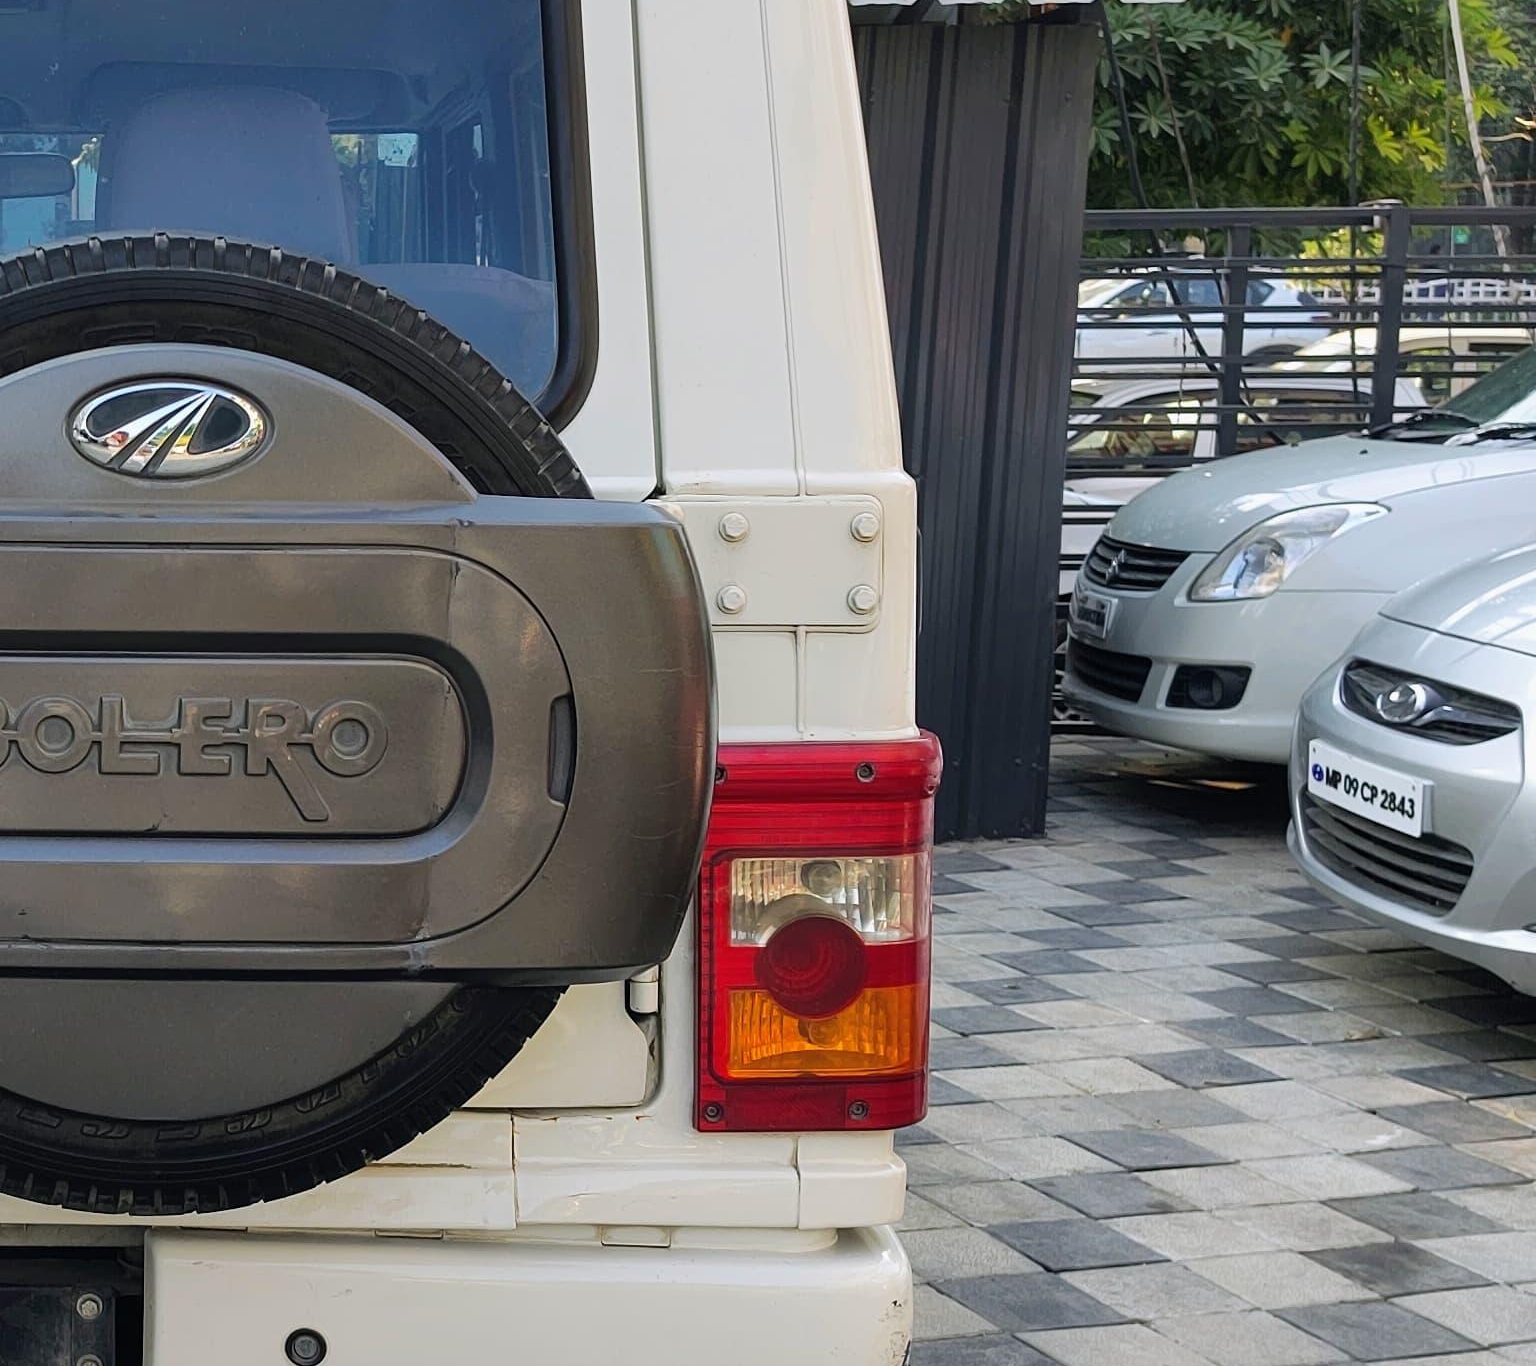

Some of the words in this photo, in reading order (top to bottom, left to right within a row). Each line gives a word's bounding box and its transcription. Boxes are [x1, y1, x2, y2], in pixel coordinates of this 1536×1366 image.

[1325, 766, 1342, 790] MP
[1344, 774, 1359, 798] 09
[1360, 781, 1379, 805] CP
[1380, 789, 1415, 819] 2843
